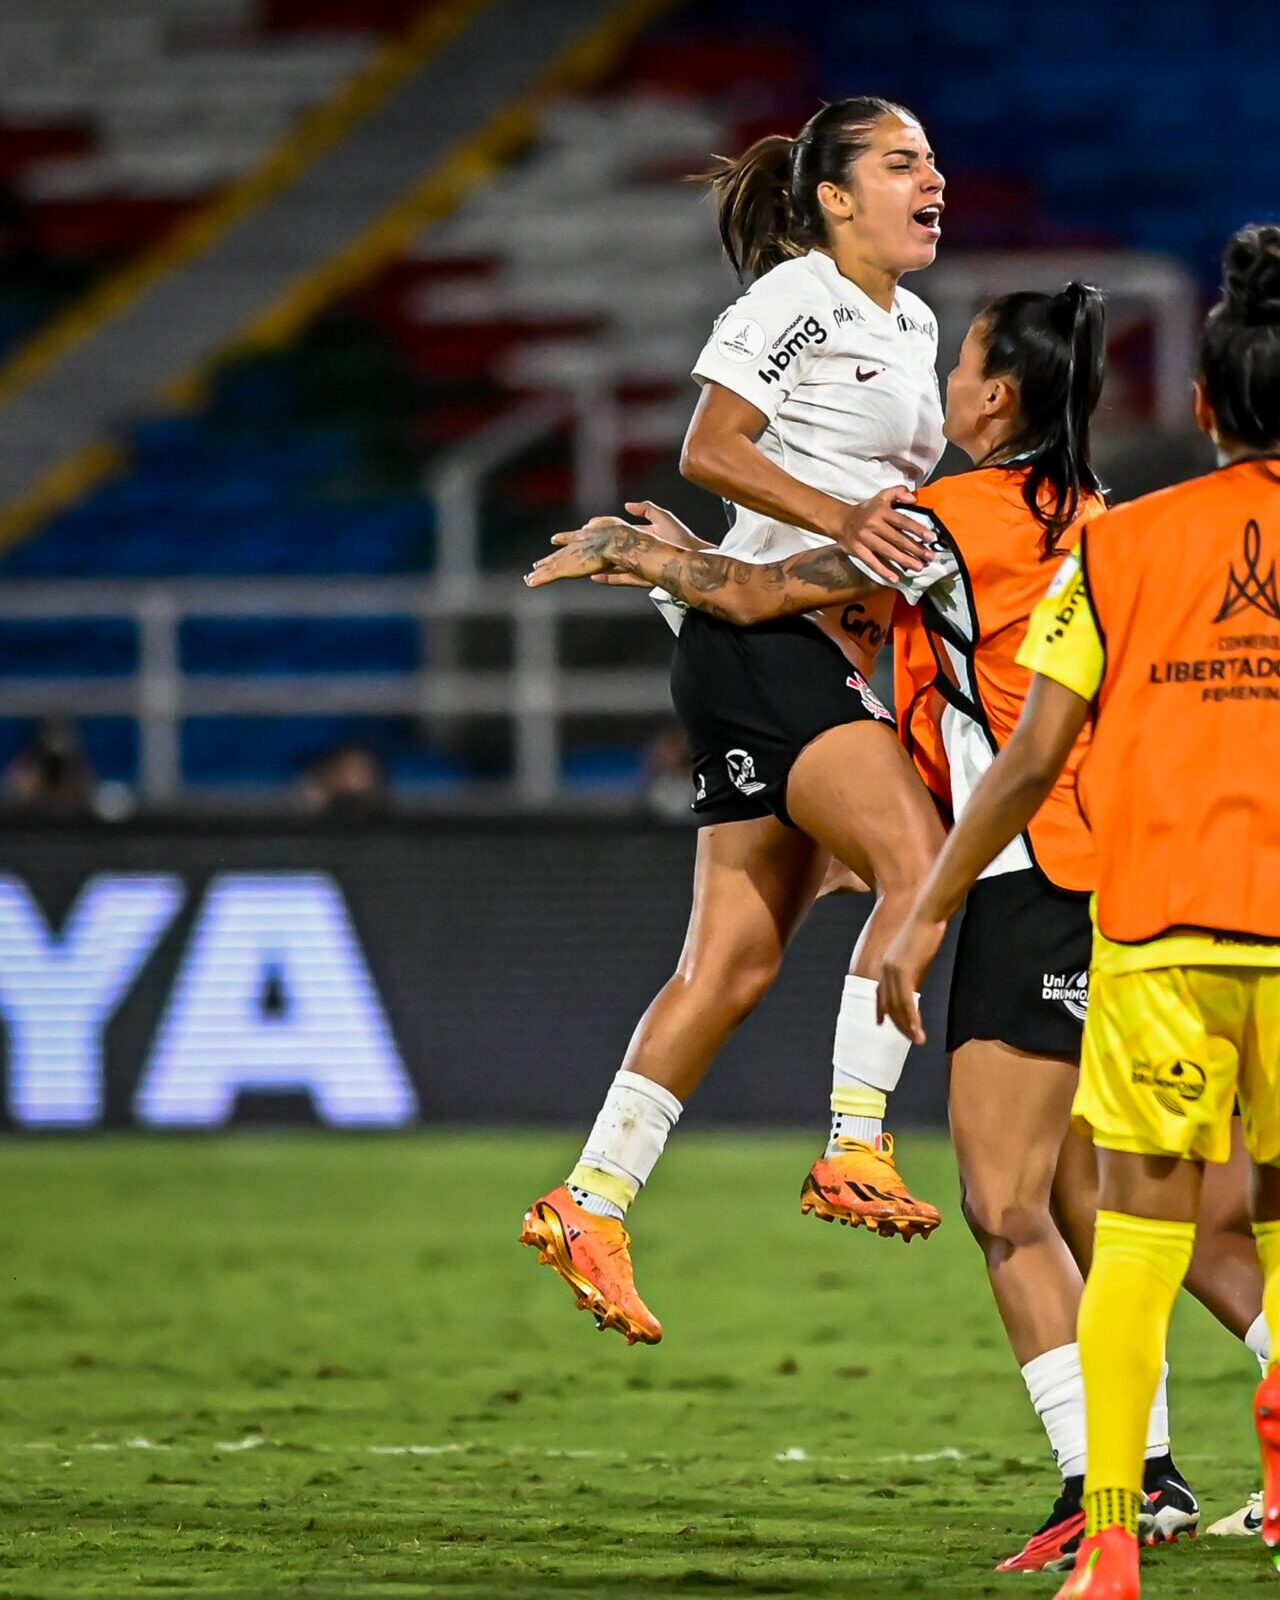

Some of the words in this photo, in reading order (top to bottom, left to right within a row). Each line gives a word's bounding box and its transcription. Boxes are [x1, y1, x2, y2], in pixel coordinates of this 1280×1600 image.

[768, 316, 827, 371] bmg
[1042, 987, 1088, 1000] DRUMMO
[1043, 973, 1066, 988] Uni
[0, 868, 420, 1130] YA
